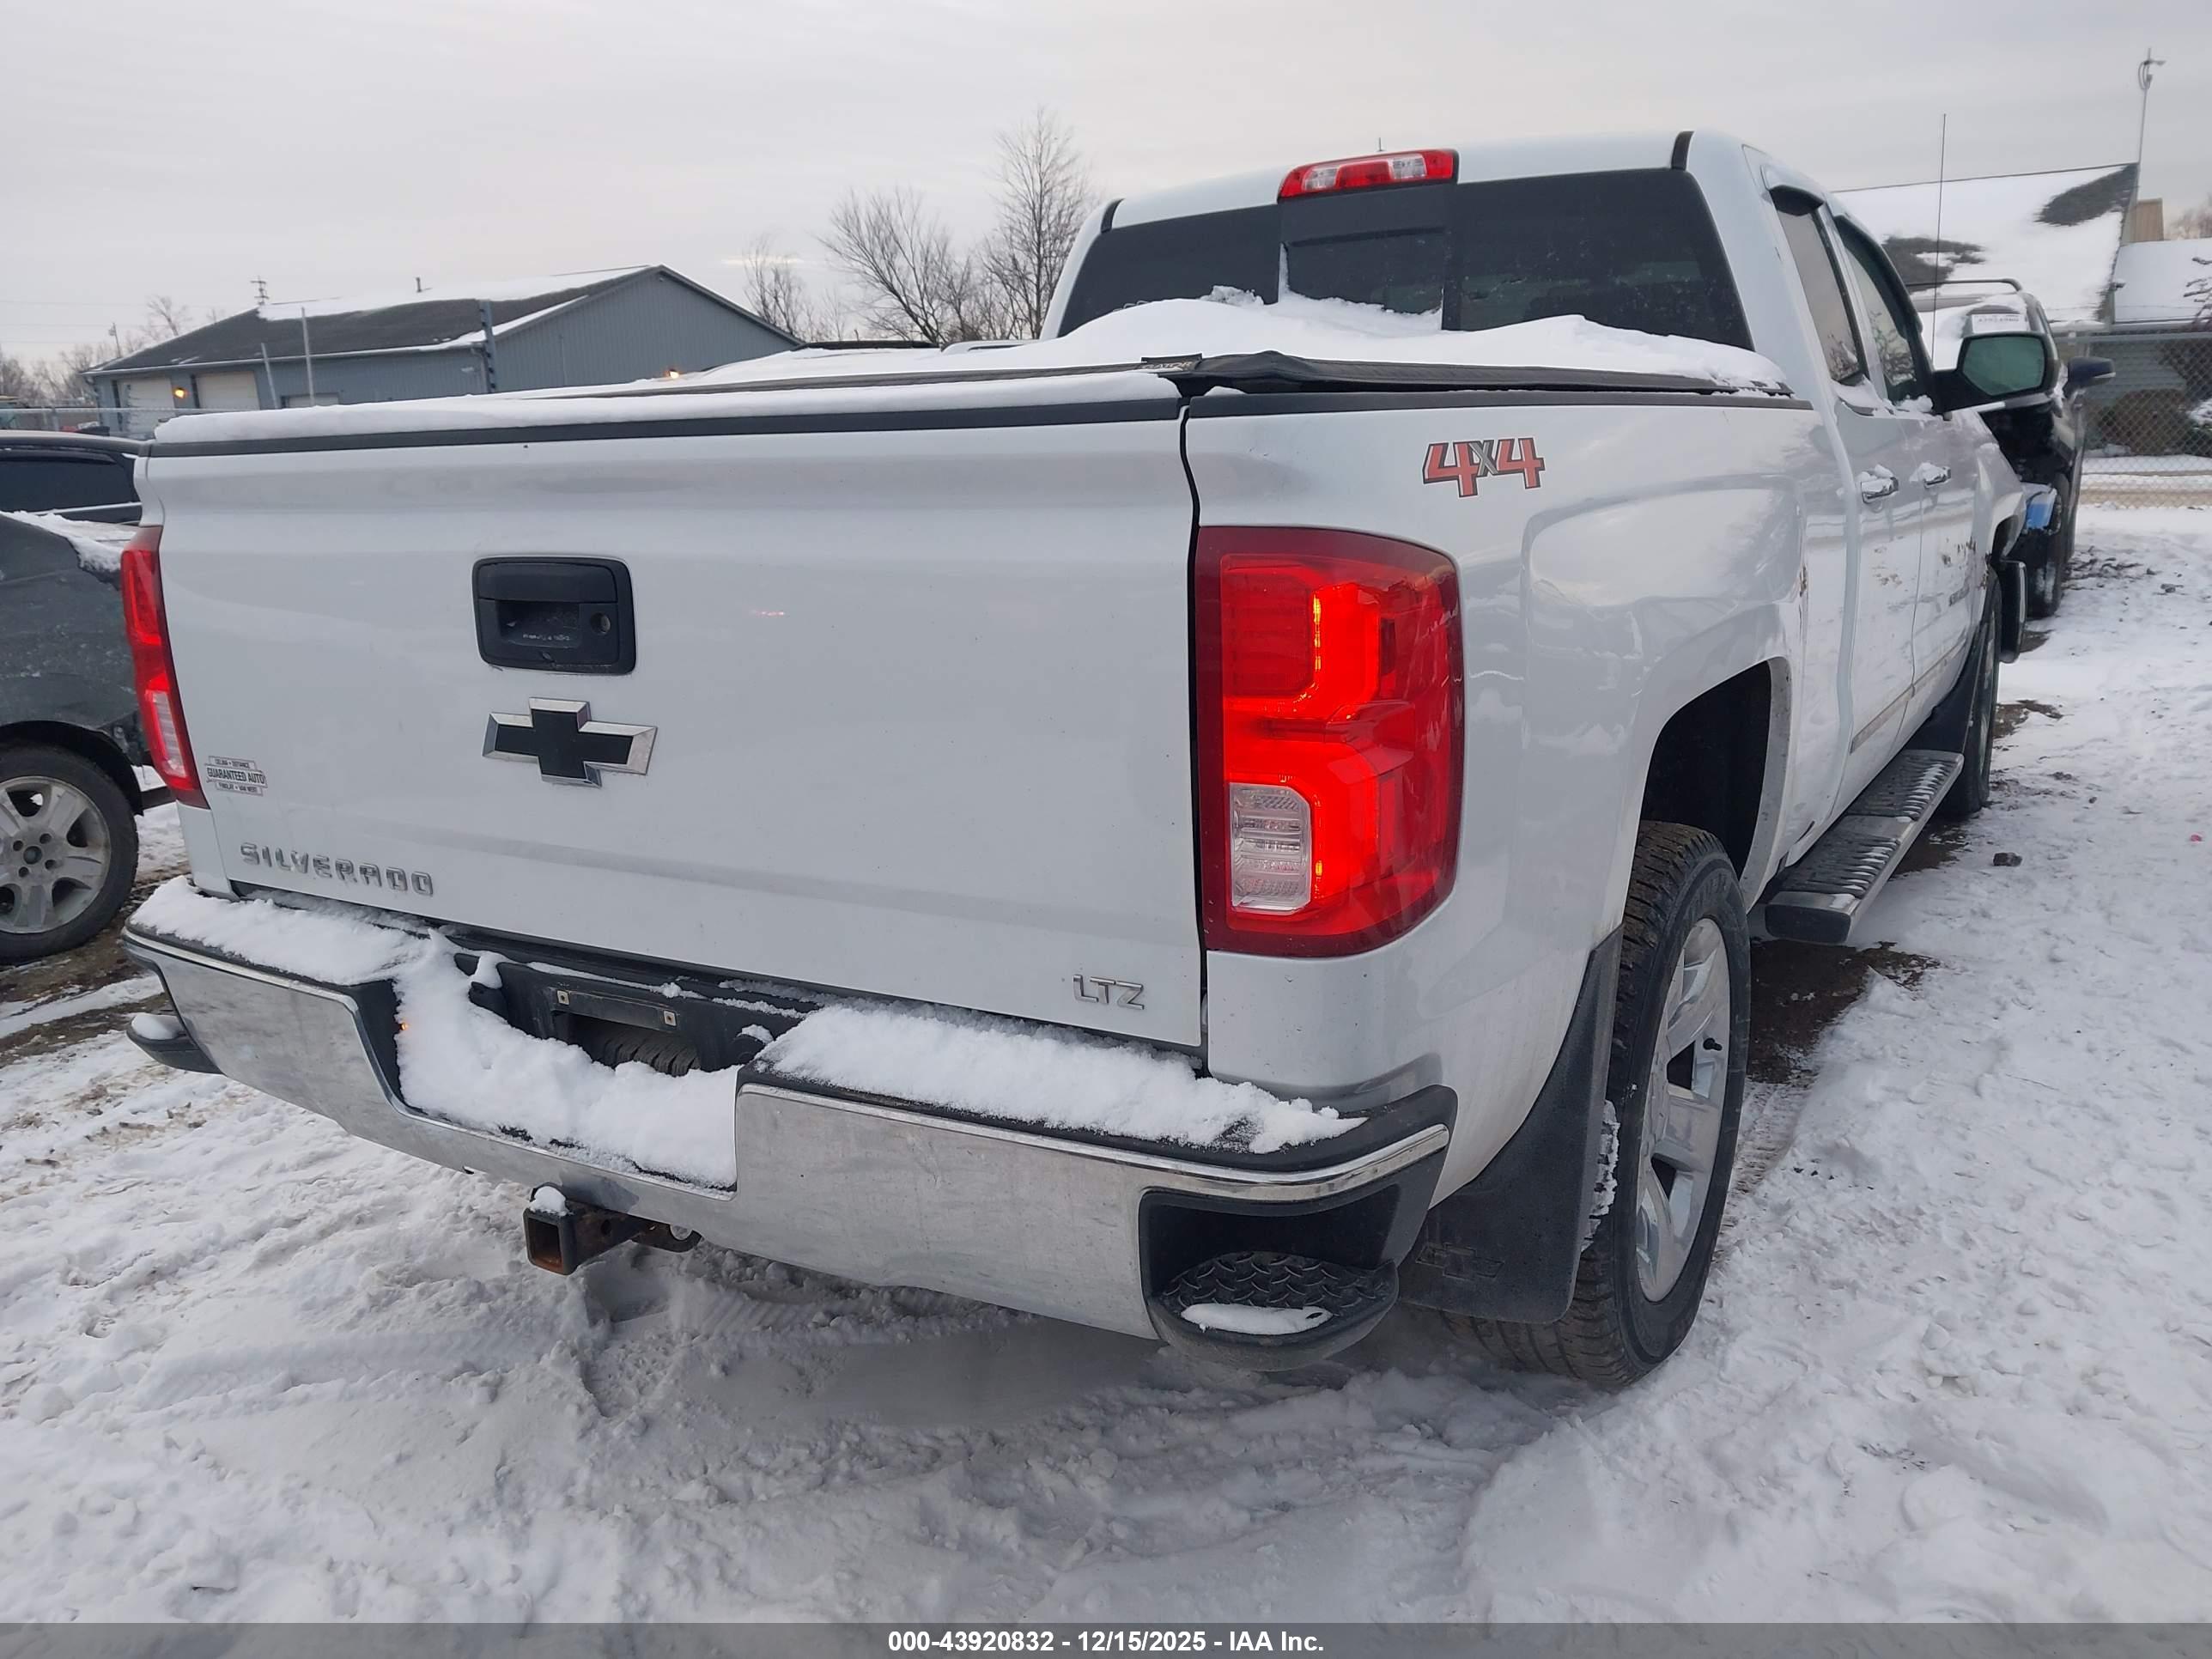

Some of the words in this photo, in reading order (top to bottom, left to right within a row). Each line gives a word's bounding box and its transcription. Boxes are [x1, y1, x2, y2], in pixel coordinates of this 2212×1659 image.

[207, 767, 247, 781] GUARANTEED
[248, 773, 265, 784] AUTO
[240, 842, 434, 897] SILVERADO
[1073, 975, 1145, 1010] LTZ
